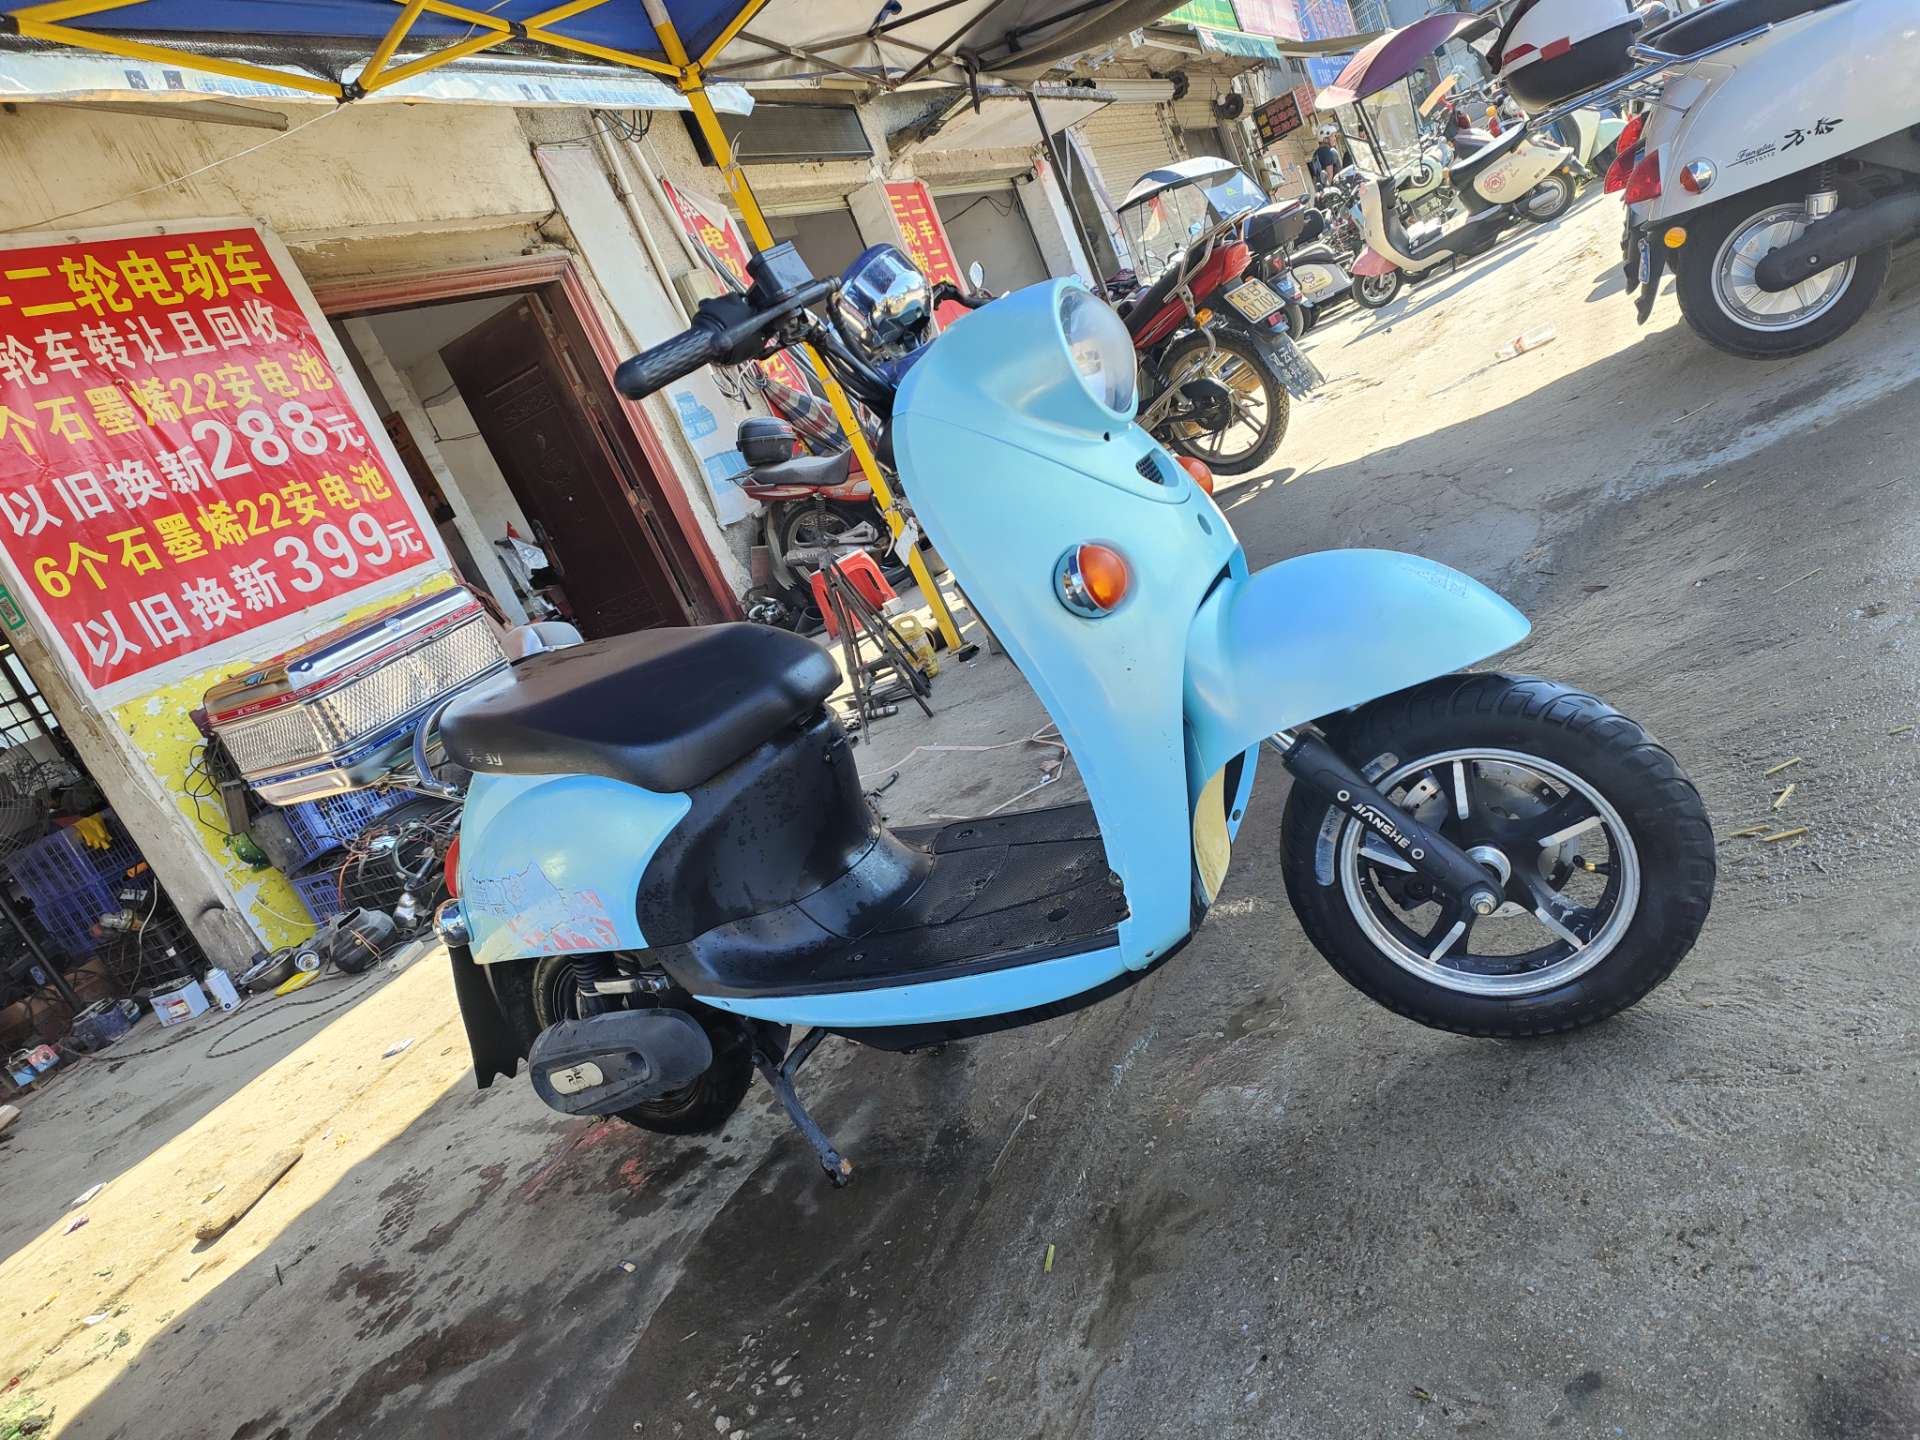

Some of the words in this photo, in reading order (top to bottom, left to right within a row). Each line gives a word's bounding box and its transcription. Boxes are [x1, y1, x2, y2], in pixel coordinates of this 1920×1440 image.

[0, 241, 271, 317] 二轮电动车
[0, 299, 287, 389] 轮车转让且回收
[0, 401, 365, 538] 以旧换新288元
[34, 460, 391, 598] 6个石墨烯22安电池
[72, 512, 423, 667] 以旧换新399元
[1352, 803, 1410, 849] JIANSHE
